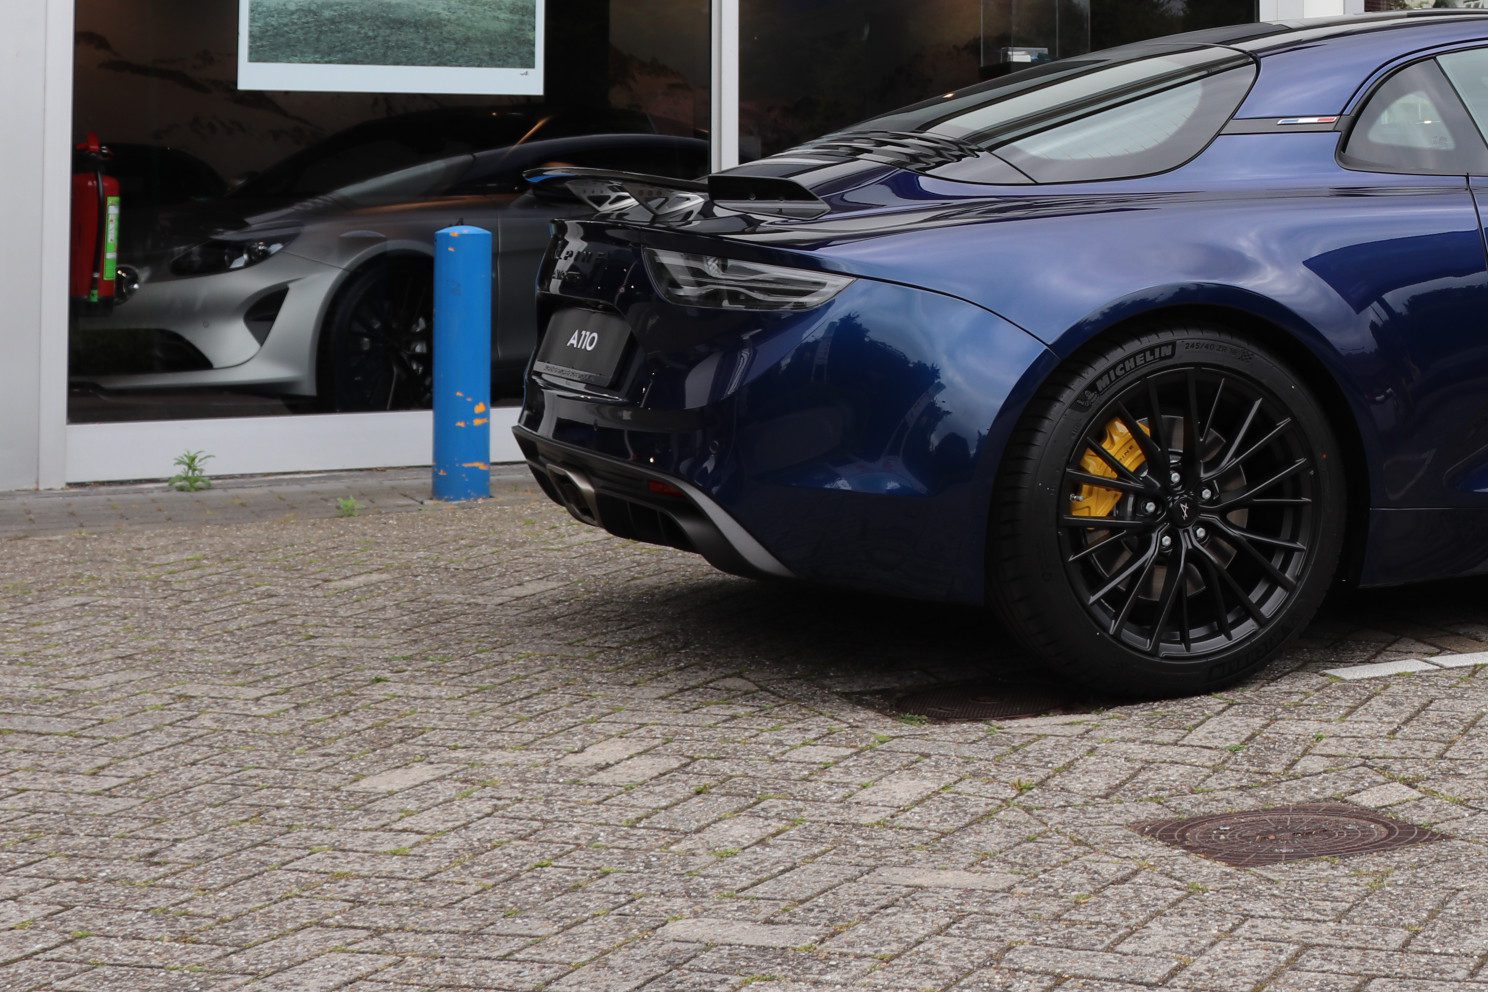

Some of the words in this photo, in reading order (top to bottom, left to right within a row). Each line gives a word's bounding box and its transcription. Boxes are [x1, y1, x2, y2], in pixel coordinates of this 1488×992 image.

[566, 328, 599, 351] A110
[1185, 342, 1215, 352] 245/40
[1096, 344, 1173, 391] MICHELIN
